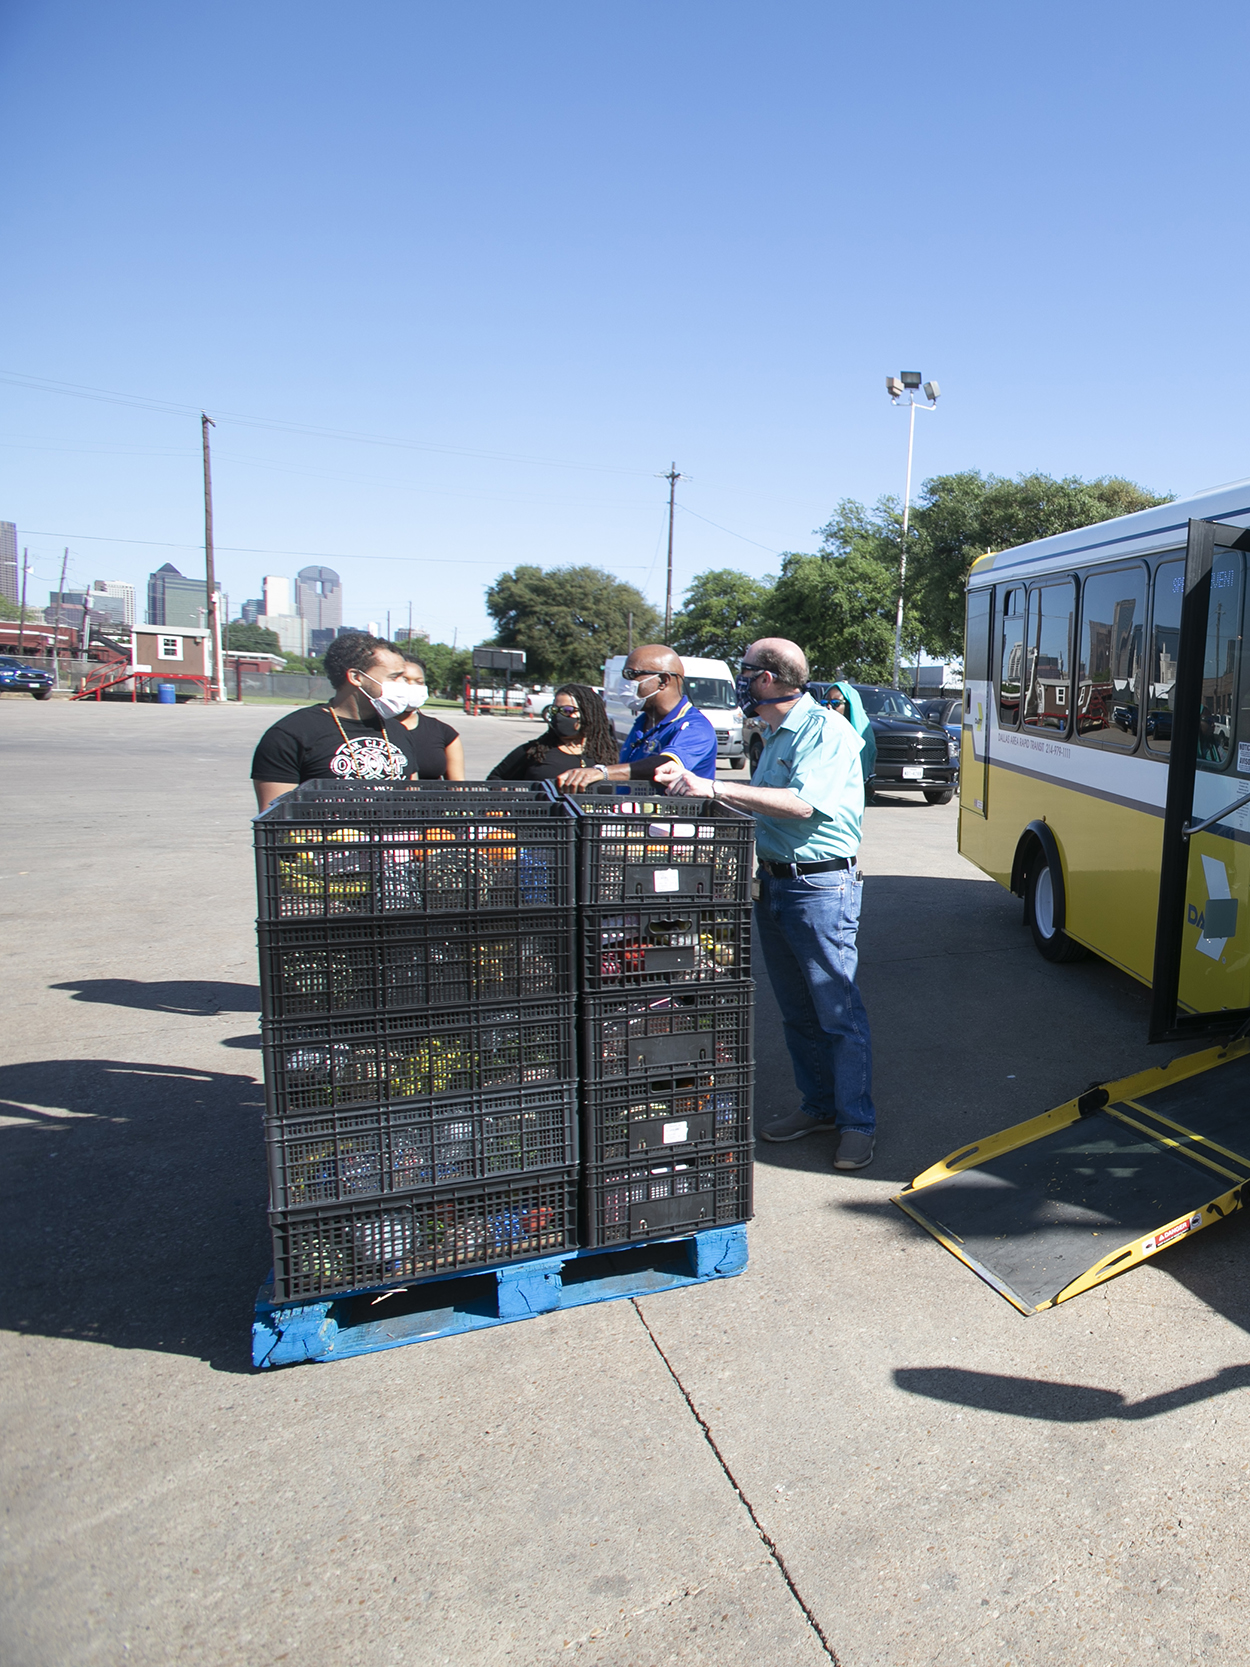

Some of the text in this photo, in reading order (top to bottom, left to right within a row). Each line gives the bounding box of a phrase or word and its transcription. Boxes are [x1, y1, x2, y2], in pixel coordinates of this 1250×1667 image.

[998, 733, 1010, 744] DALLAS
[1010, 736, 1019, 745] AREA
[1019, 738, 1030, 749] RAPID
[1030, 741, 1045, 752] TRANSIT
[1163, 1221, 1188, 1239] DANGER
